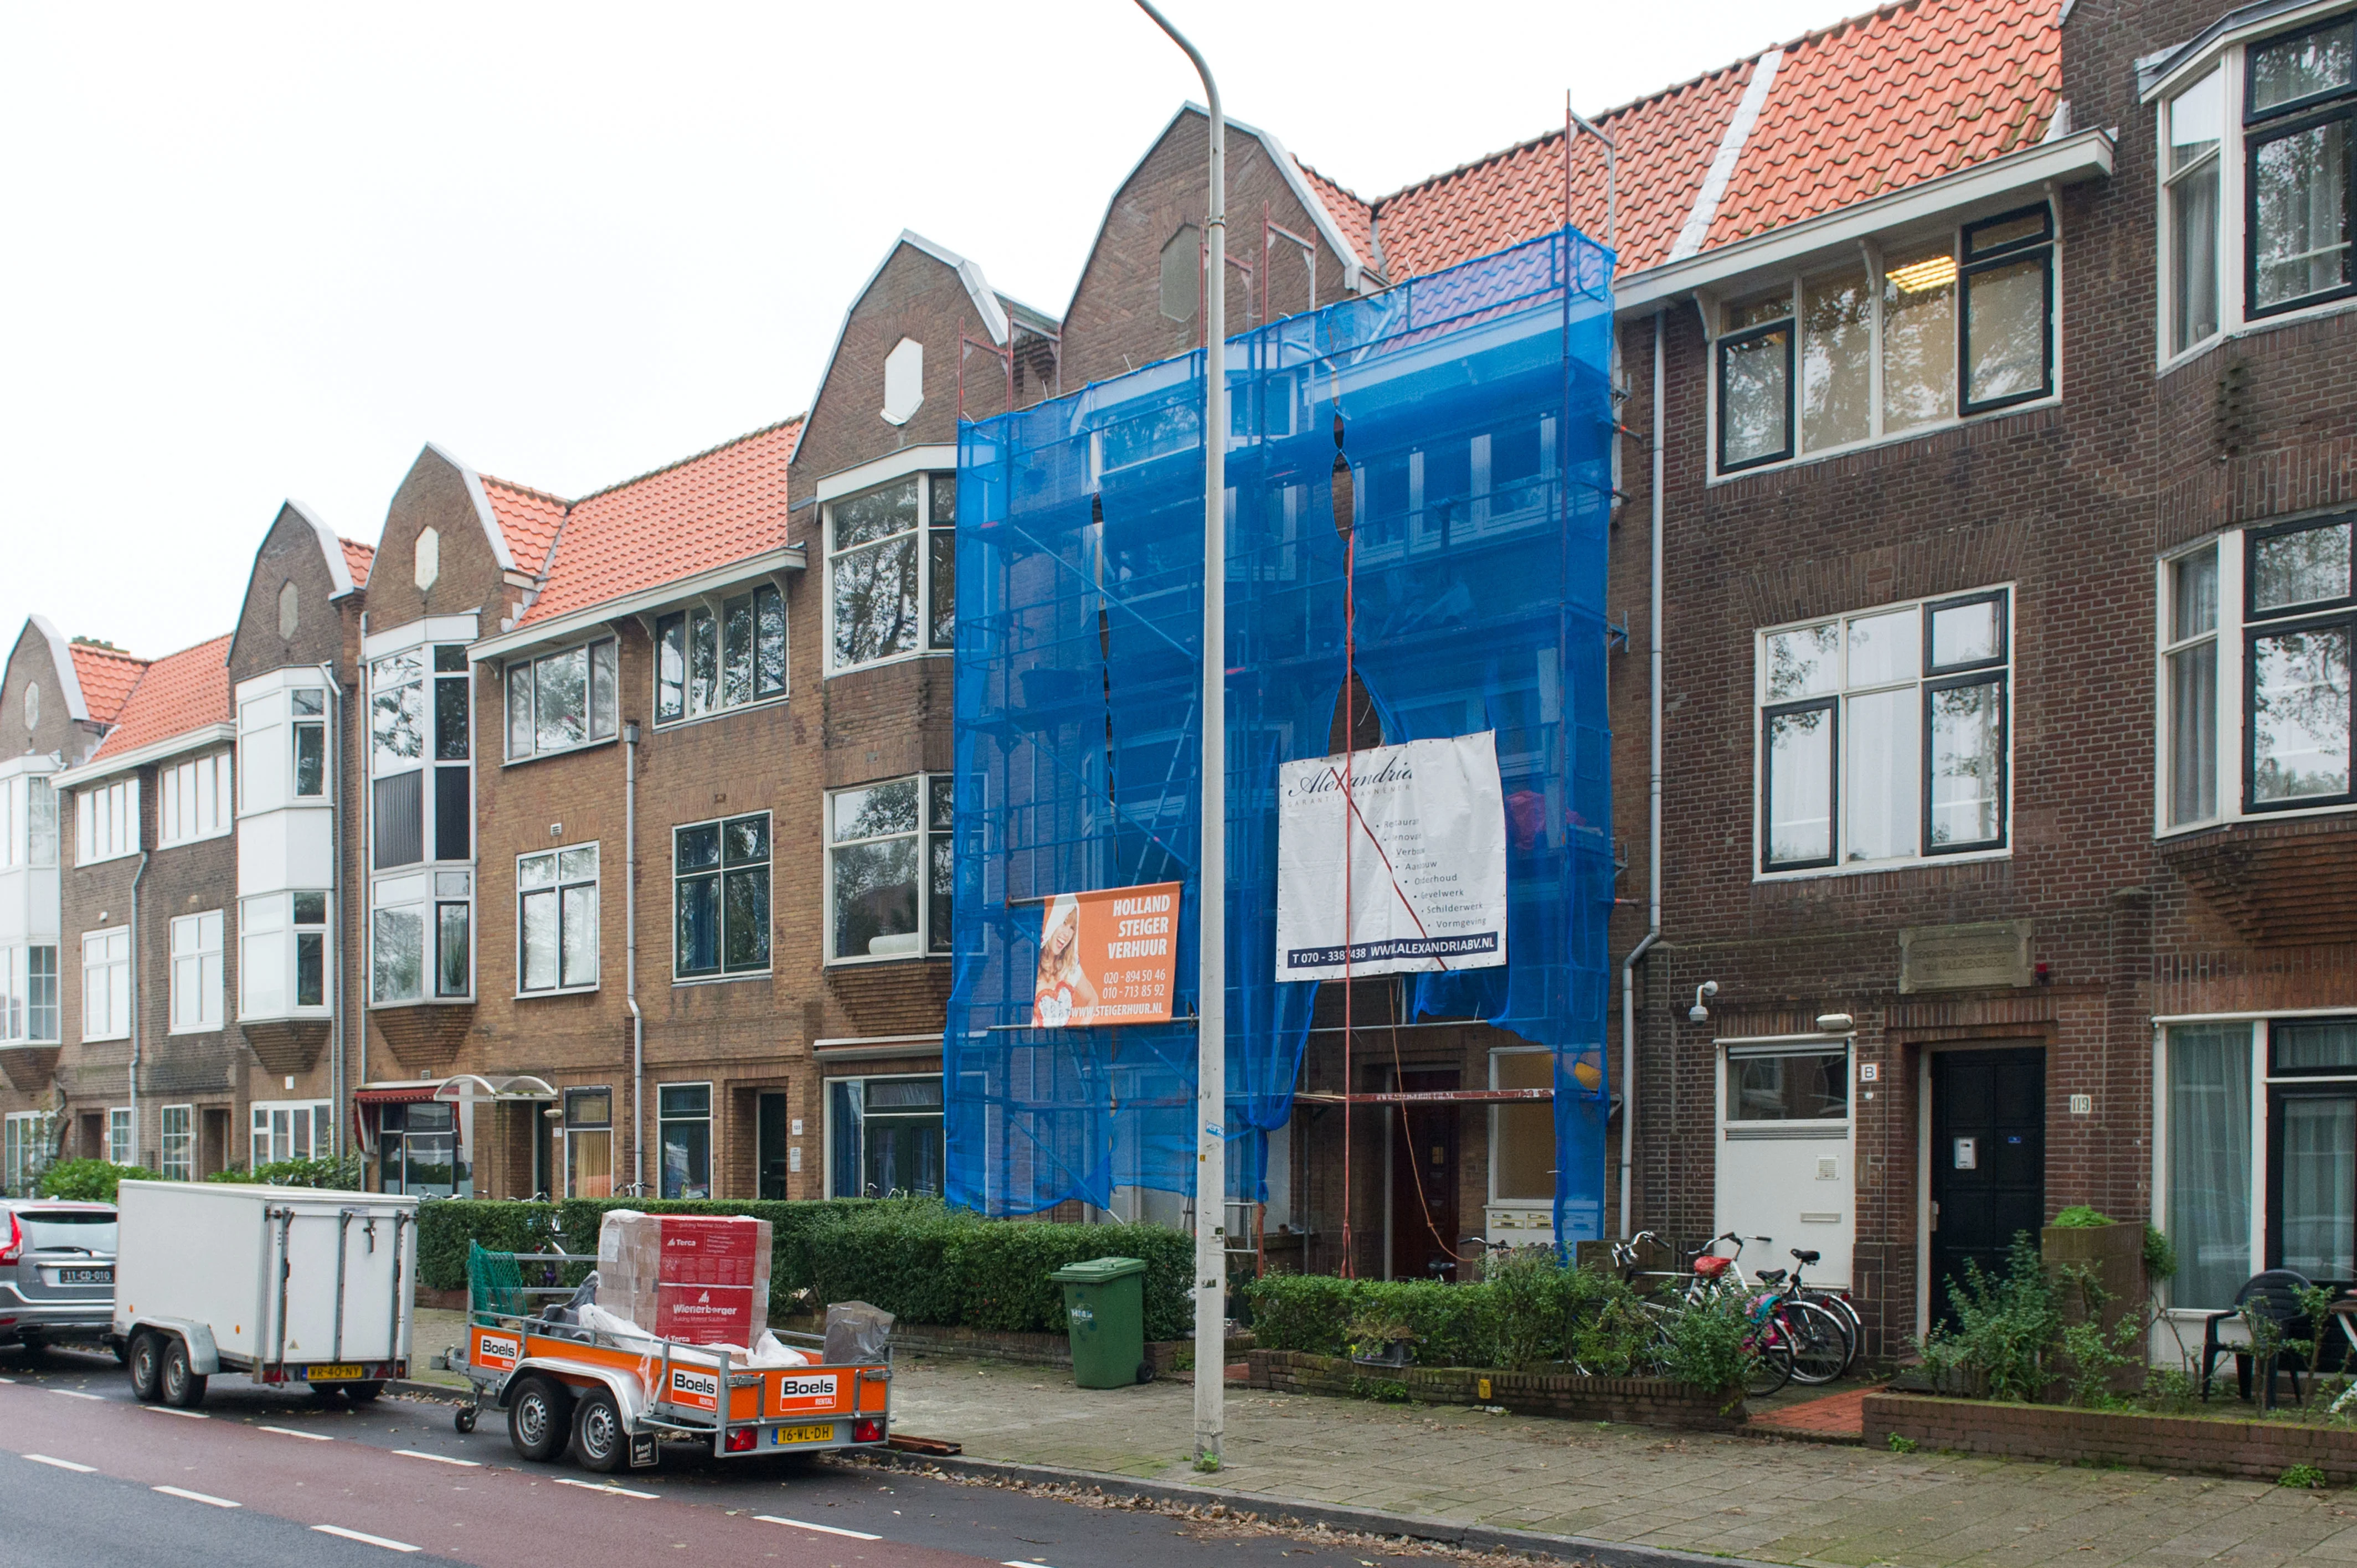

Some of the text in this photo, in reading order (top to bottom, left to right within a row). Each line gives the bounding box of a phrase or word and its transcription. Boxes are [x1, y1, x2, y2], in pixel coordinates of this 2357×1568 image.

[1113, 894, 1171, 916] HOLLAND
[1427, 902, 1483, 914] Schilderwerk
[1118, 916, 1169, 937] STEIGER
[1437, 917, 1487, 929] Vormgeving
[1108, 938, 1167, 960] VERHUUR
[1293, 953, 1299, 964] T
[1301, 952, 1319, 963] 070
[1103, 972, 1119, 984] 020
[1125, 970, 1141, 983] 894
[1141, 969, 1152, 982] 50
[1155, 968, 1166, 981] 46
[1103, 987, 1118, 999] 010
[1124, 985, 1139, 998] 713
[1141, 984, 1152, 997] 85
[1154, 984, 1165, 996] 92
[1071, 1002, 1163, 1018] WWW.STEIGERHUUR.NL
[1865, 1066, 1874, 1078] B
[2072, 1097, 2089, 1112] 119
[673, 1304, 737, 1315] Wienerberger
[482, 1339, 514, 1356] Boels
[675, 1373, 715, 1394] Boels
[784, 1379, 834, 1395] Boels
[698, 1397, 714, 1407] RENTAL
[782, 1426, 830, 1441] 16-WL-DH
